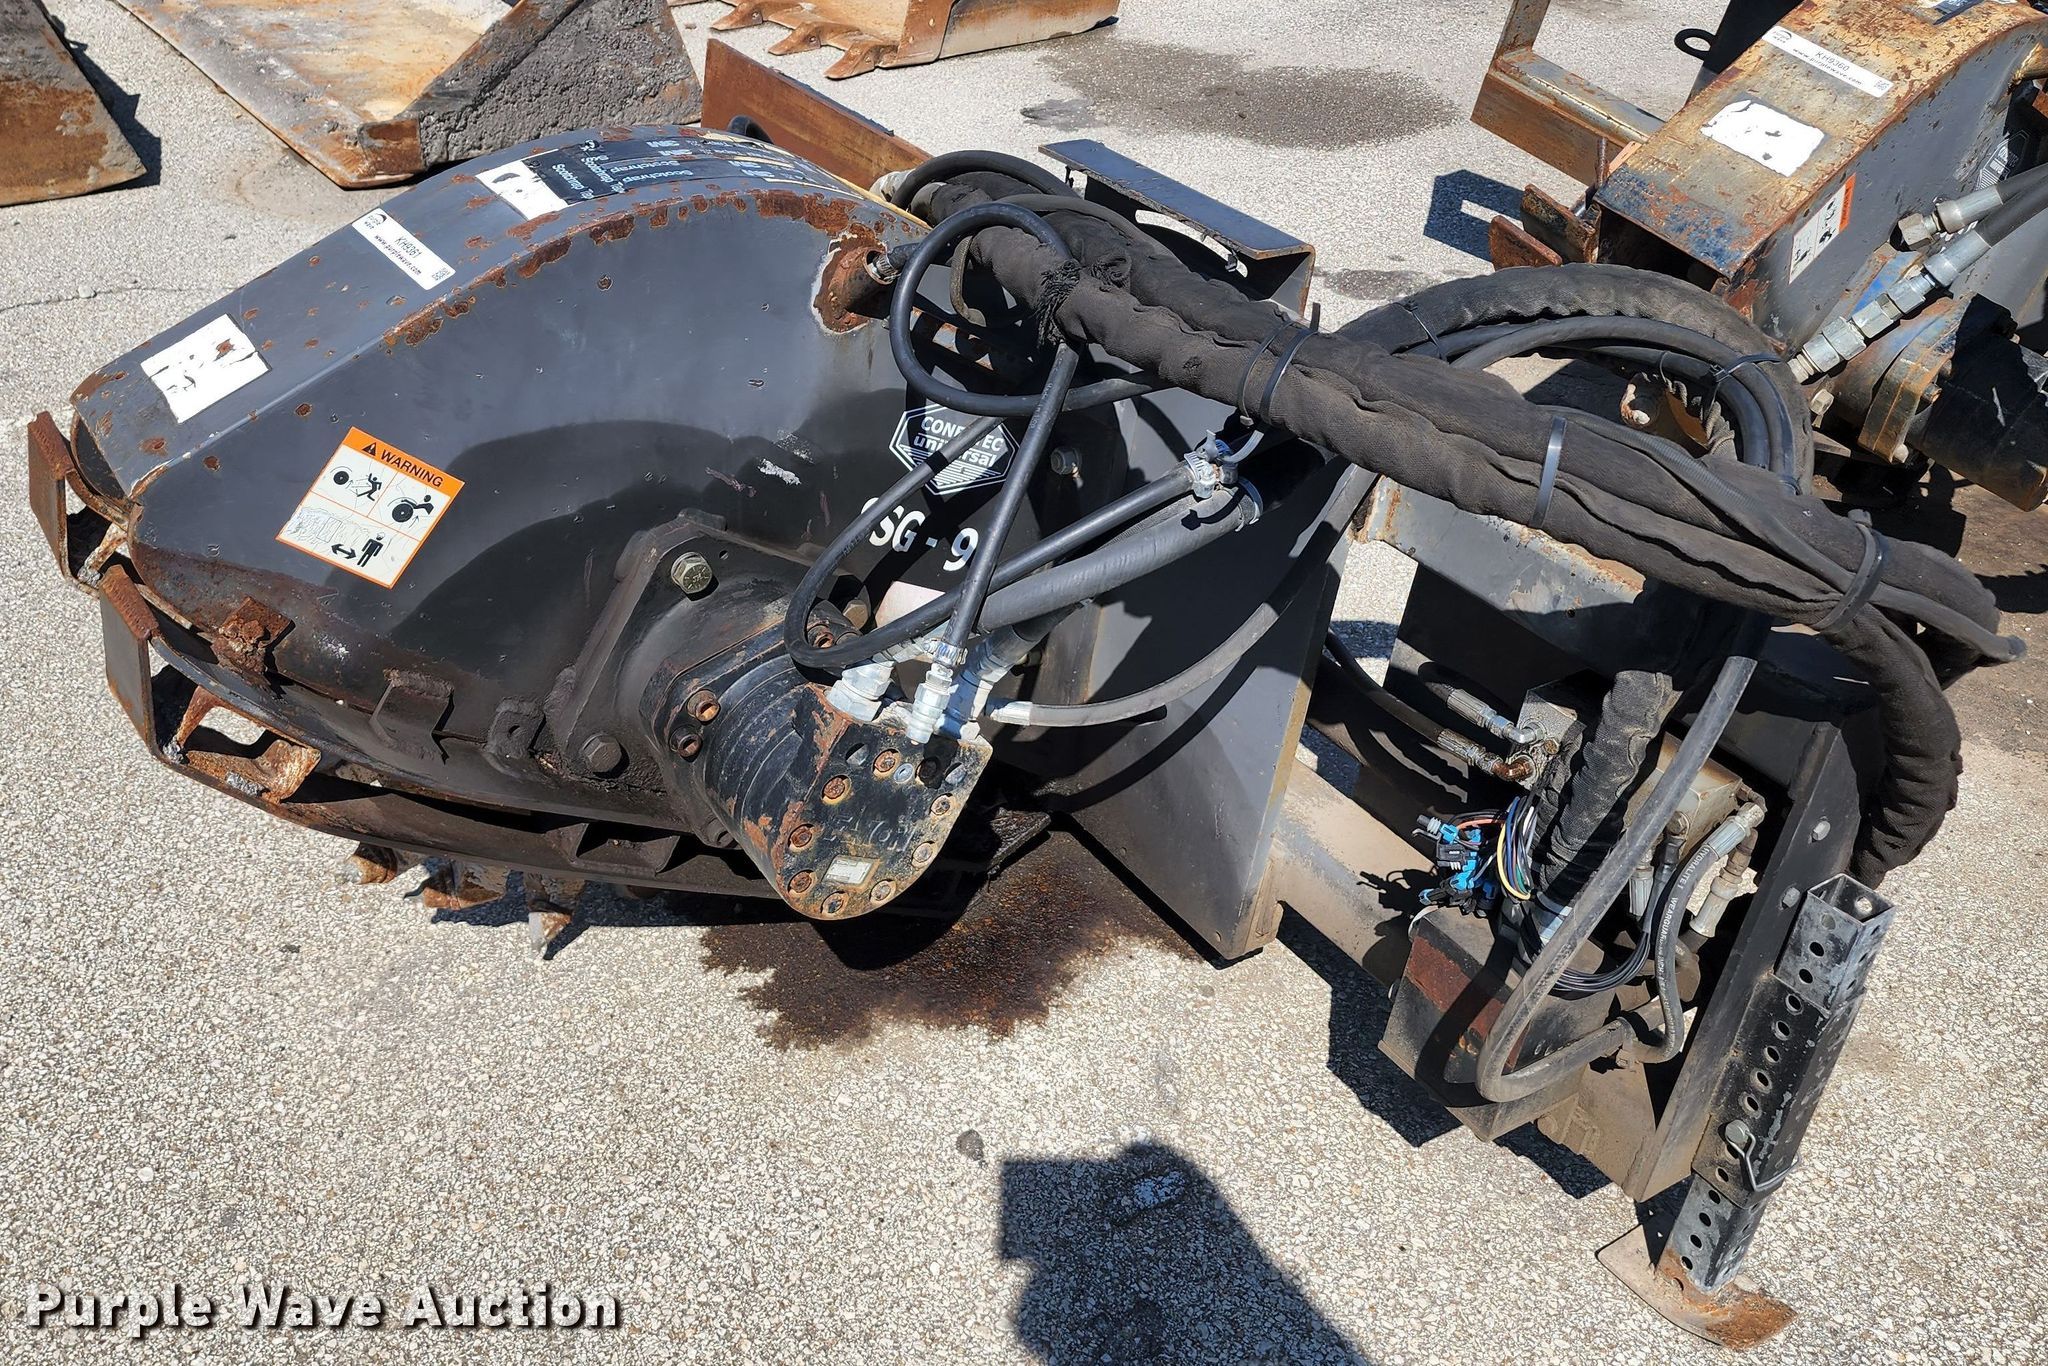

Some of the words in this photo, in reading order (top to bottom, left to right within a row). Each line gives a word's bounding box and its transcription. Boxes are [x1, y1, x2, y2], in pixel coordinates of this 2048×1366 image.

[1815, 51, 1850, 72] KH9360
[622, 169, 695, 183] Scotchrap
[374, 235, 422, 276] www.purplewave.com
[395, 236, 422, 259] KH9361
[921, 416, 1004, 452] CONEC
[381, 449, 444, 488] WARNING
[914, 435, 998, 469] unirsal
